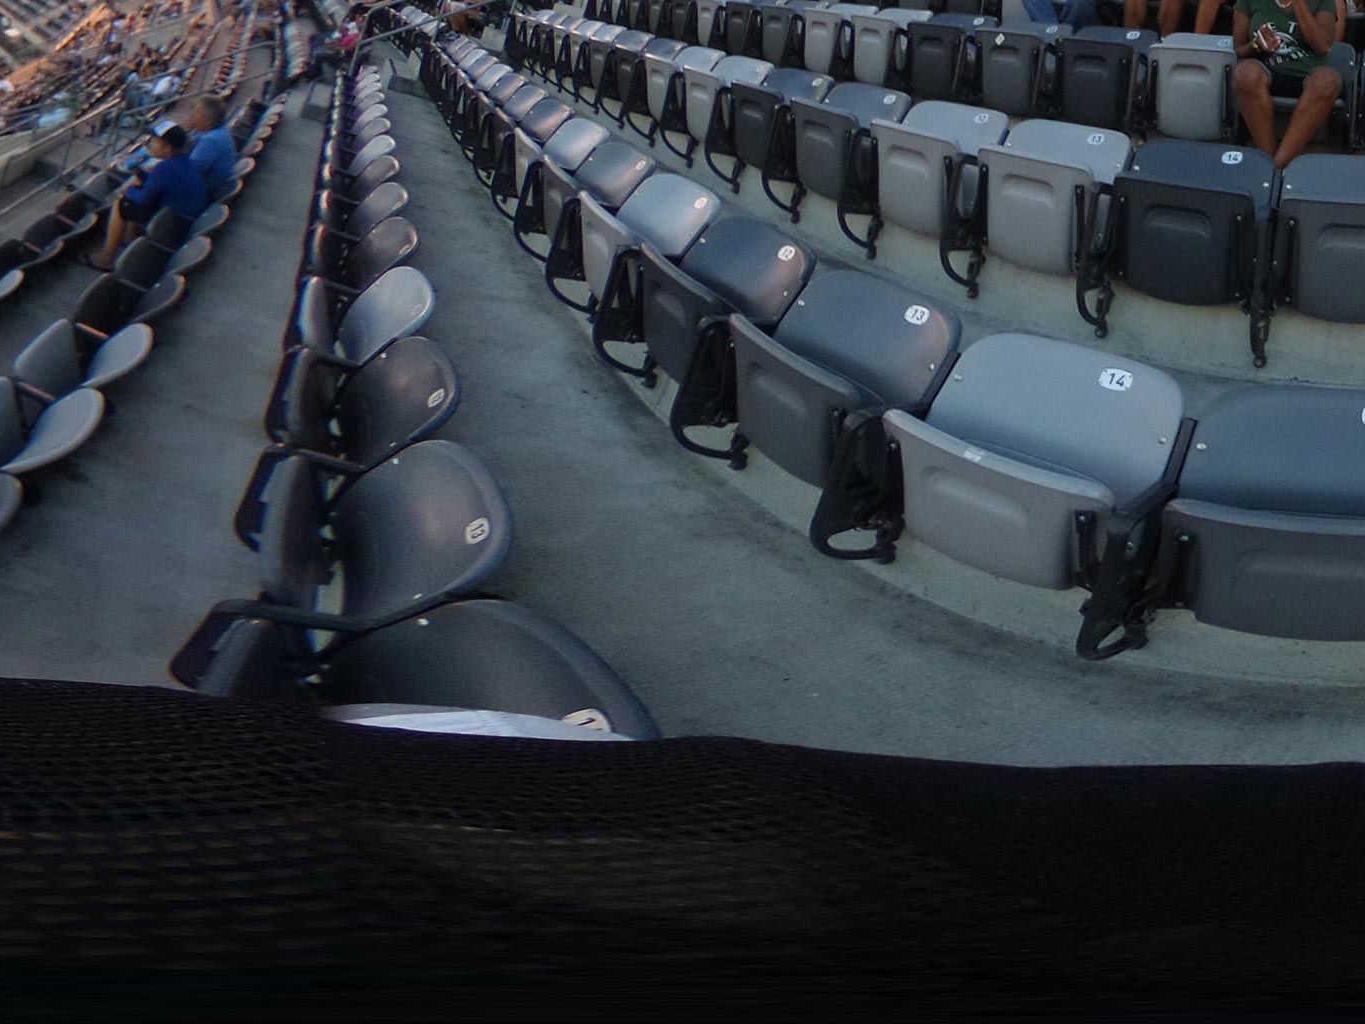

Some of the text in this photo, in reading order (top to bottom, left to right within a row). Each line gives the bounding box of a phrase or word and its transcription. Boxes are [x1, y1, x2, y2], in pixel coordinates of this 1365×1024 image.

[1225, 152, 1240, 163] 14
[909, 307, 926, 322] 13
[1106, 371, 1128, 388] 14
